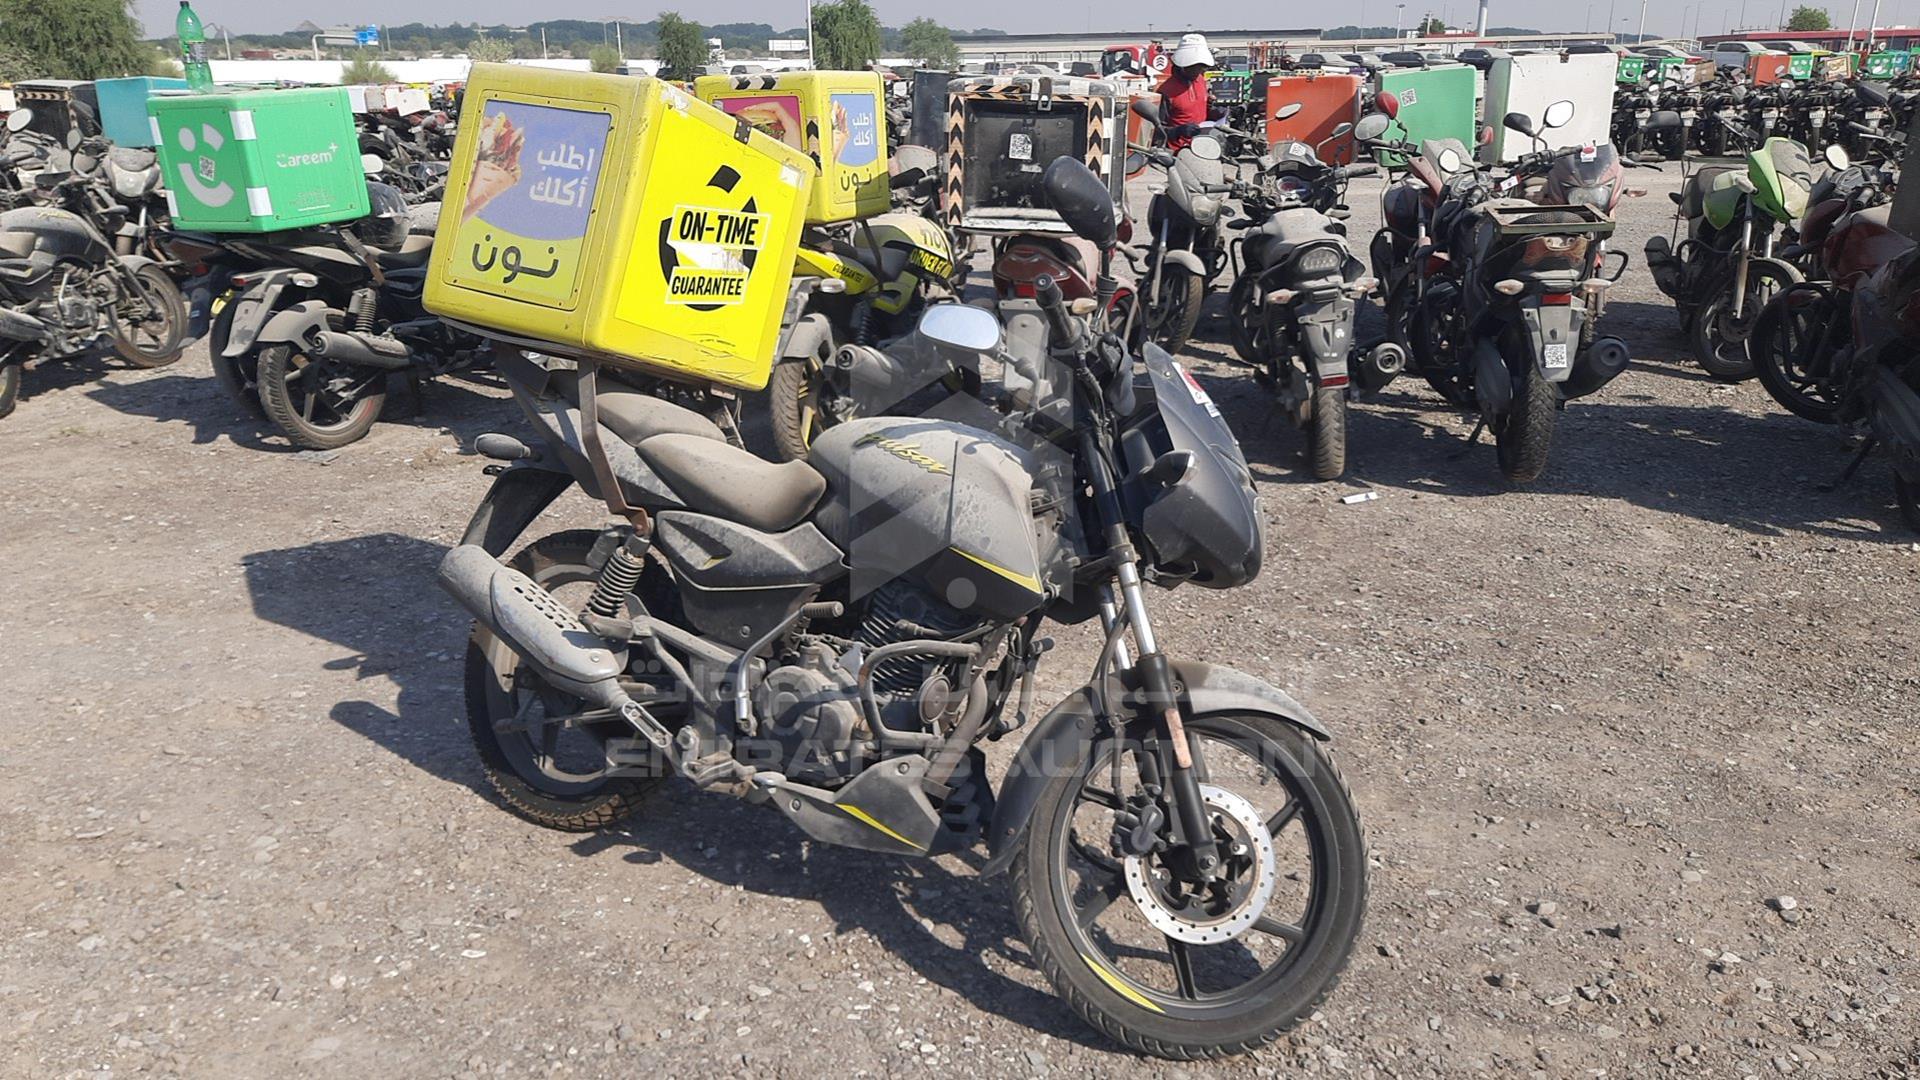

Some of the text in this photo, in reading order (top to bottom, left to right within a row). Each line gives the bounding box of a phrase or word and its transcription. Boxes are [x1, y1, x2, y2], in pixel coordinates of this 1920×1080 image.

[852, 112, 873, 129] اطلب
[853, 128, 874, 146] أكلك
[537, 143, 596, 172] اطلب
[529, 176, 589, 208] أكلك
[840, 167, 872, 194] نون
[679, 210, 760, 246] ON-TIME
[471, 234, 560, 284] نون
[671, 275, 744, 296] GUARANTEE
